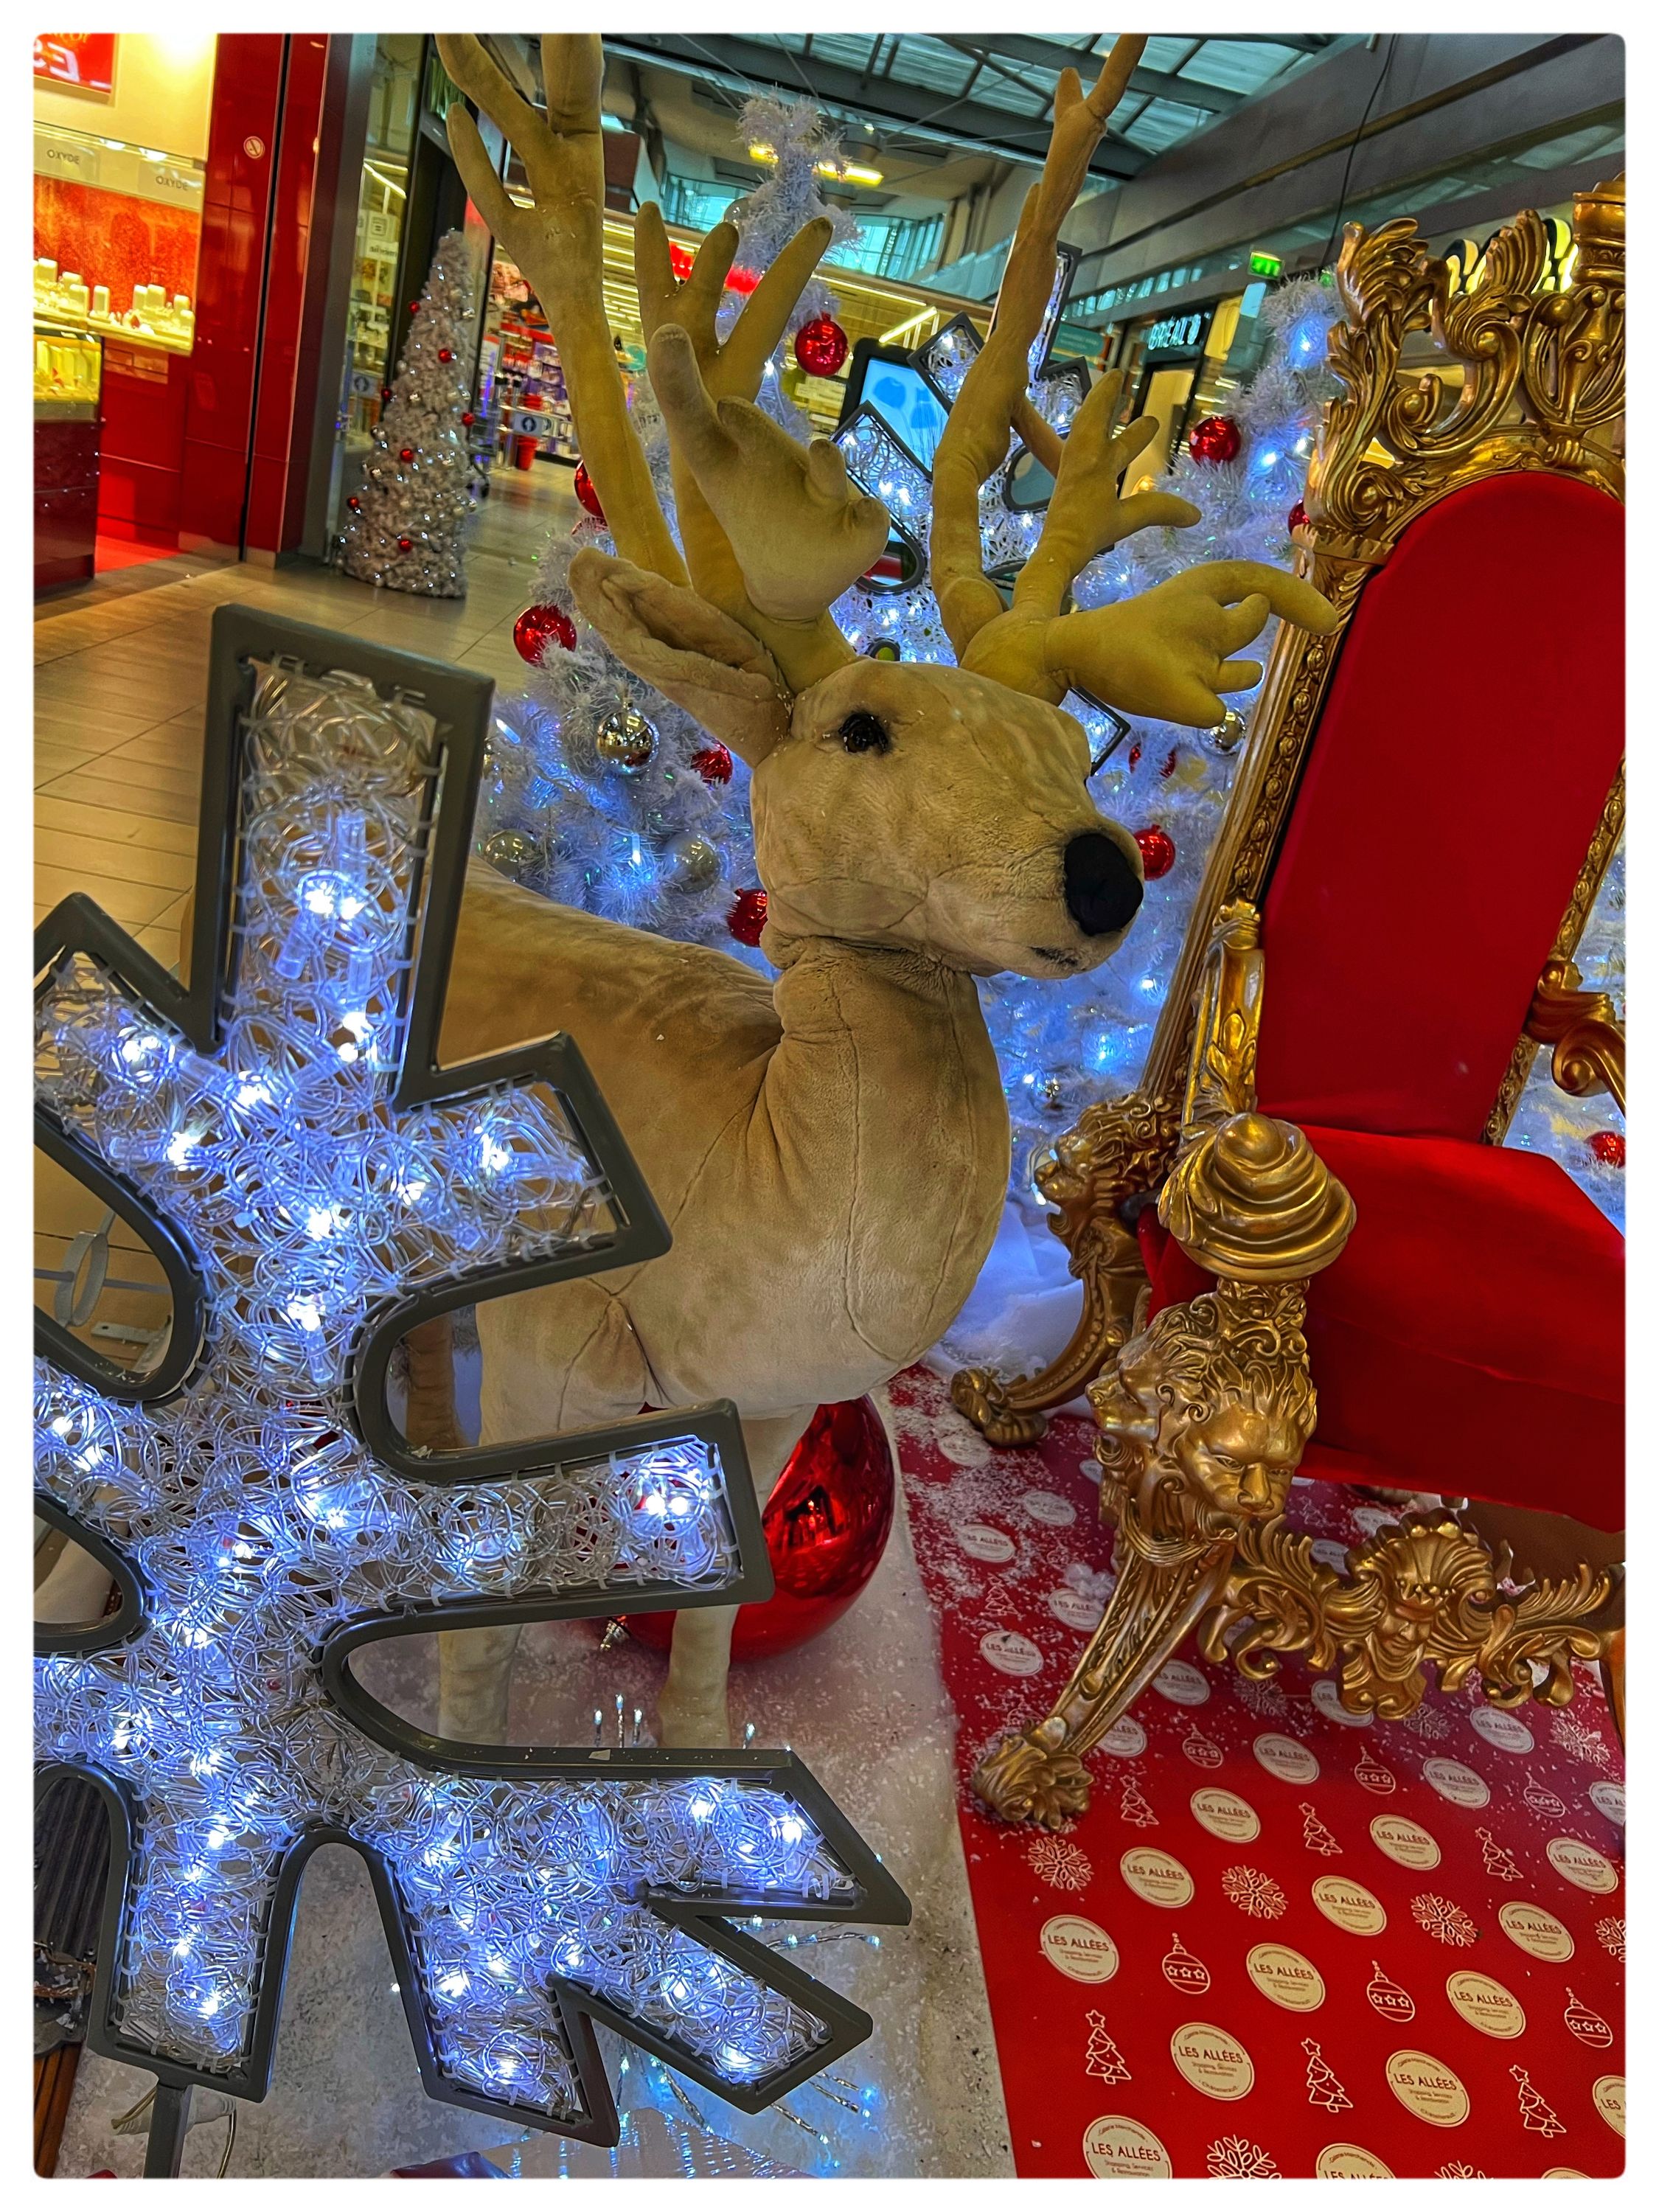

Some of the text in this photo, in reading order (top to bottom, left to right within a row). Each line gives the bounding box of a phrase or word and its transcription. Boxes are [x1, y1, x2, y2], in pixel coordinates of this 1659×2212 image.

[46, 149, 80, 164] OXYDE
[155, 175, 189, 191] OXYDE
[1127, 1864, 1146, 1875] LES
[1047, 1934, 1067, 1946] LES
[1253, 1963, 1273, 1974] LES
[1453, 1991, 1473, 2002] LES
[1178, 2045, 1199, 2058] LES
[1394, 2073, 1414, 2085] LES
[1601, 2098, 1621, 2110] LES
[1091, 2142, 1161, 2162] LES ALLÉES
